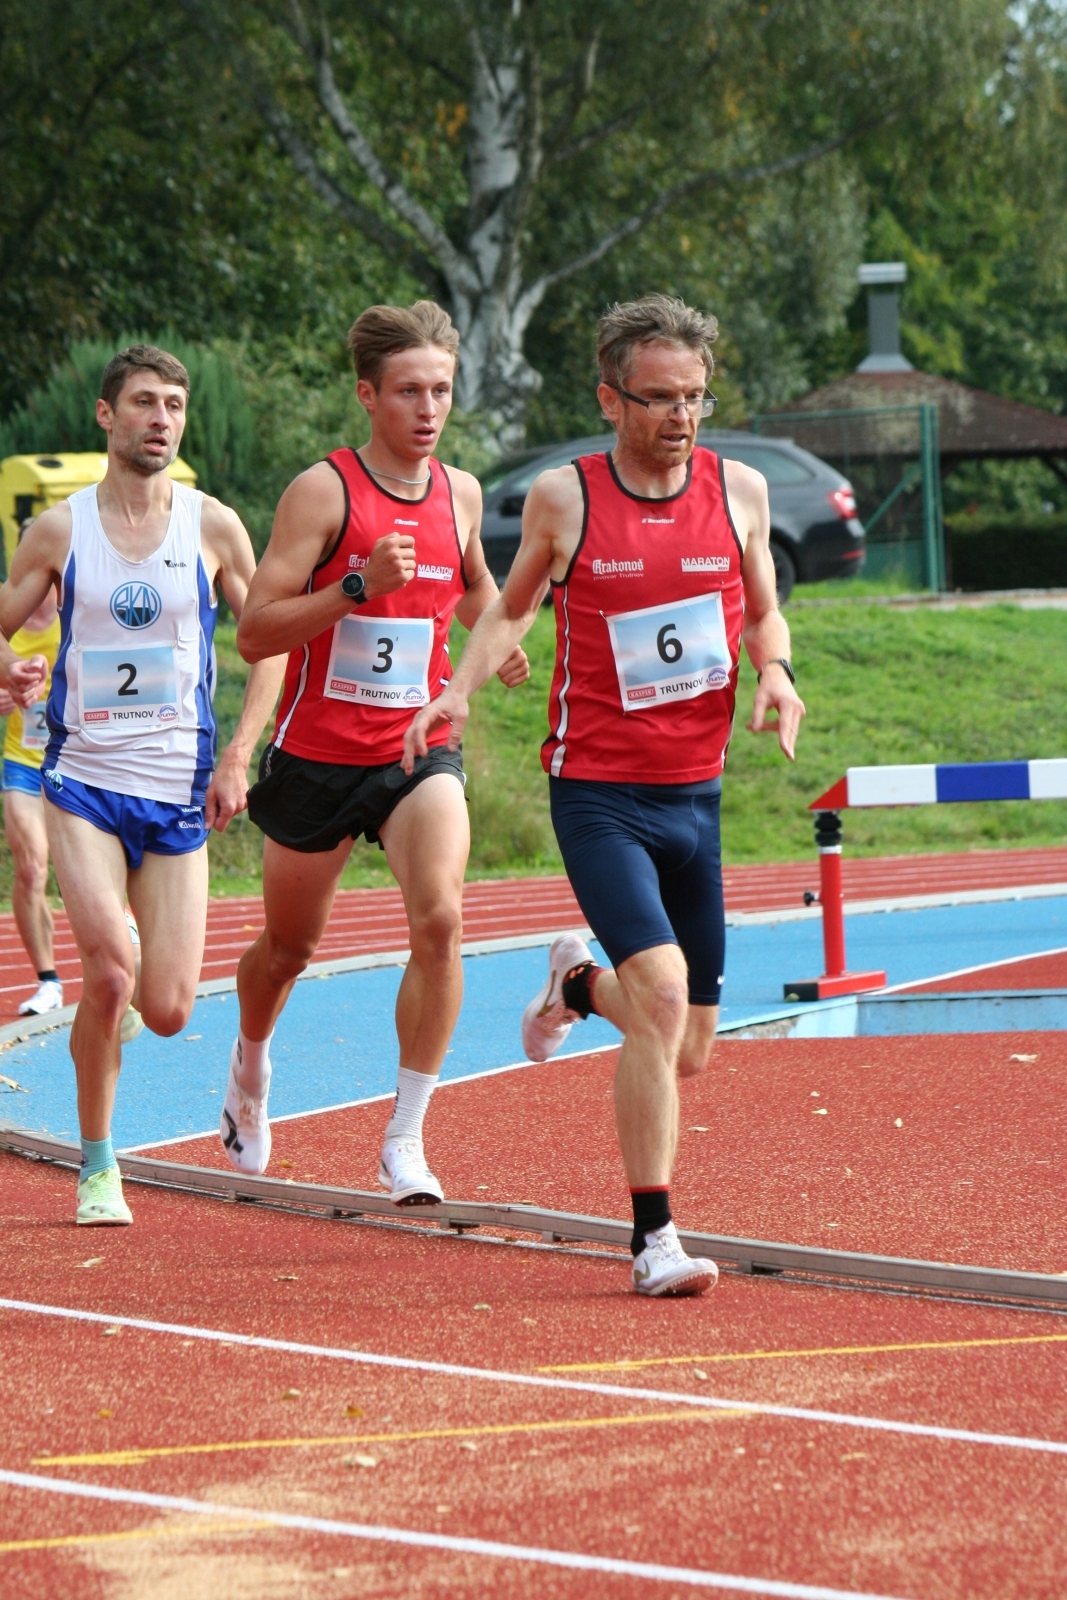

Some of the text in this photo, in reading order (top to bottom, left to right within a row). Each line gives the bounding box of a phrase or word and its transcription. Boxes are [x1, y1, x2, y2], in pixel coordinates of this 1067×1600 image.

[680, 556, 730, 566] MARATON
[417, 563, 454, 576] MARATON
[656, 623, 684, 664] 6
[371, 637, 394, 674] 3
[117, 662, 139, 697] 2
[659, 677, 704, 695] TRUTNOV
[360, 688, 401, 700] TRUTNOV
[112, 710, 154, 720] TRUTNOV
